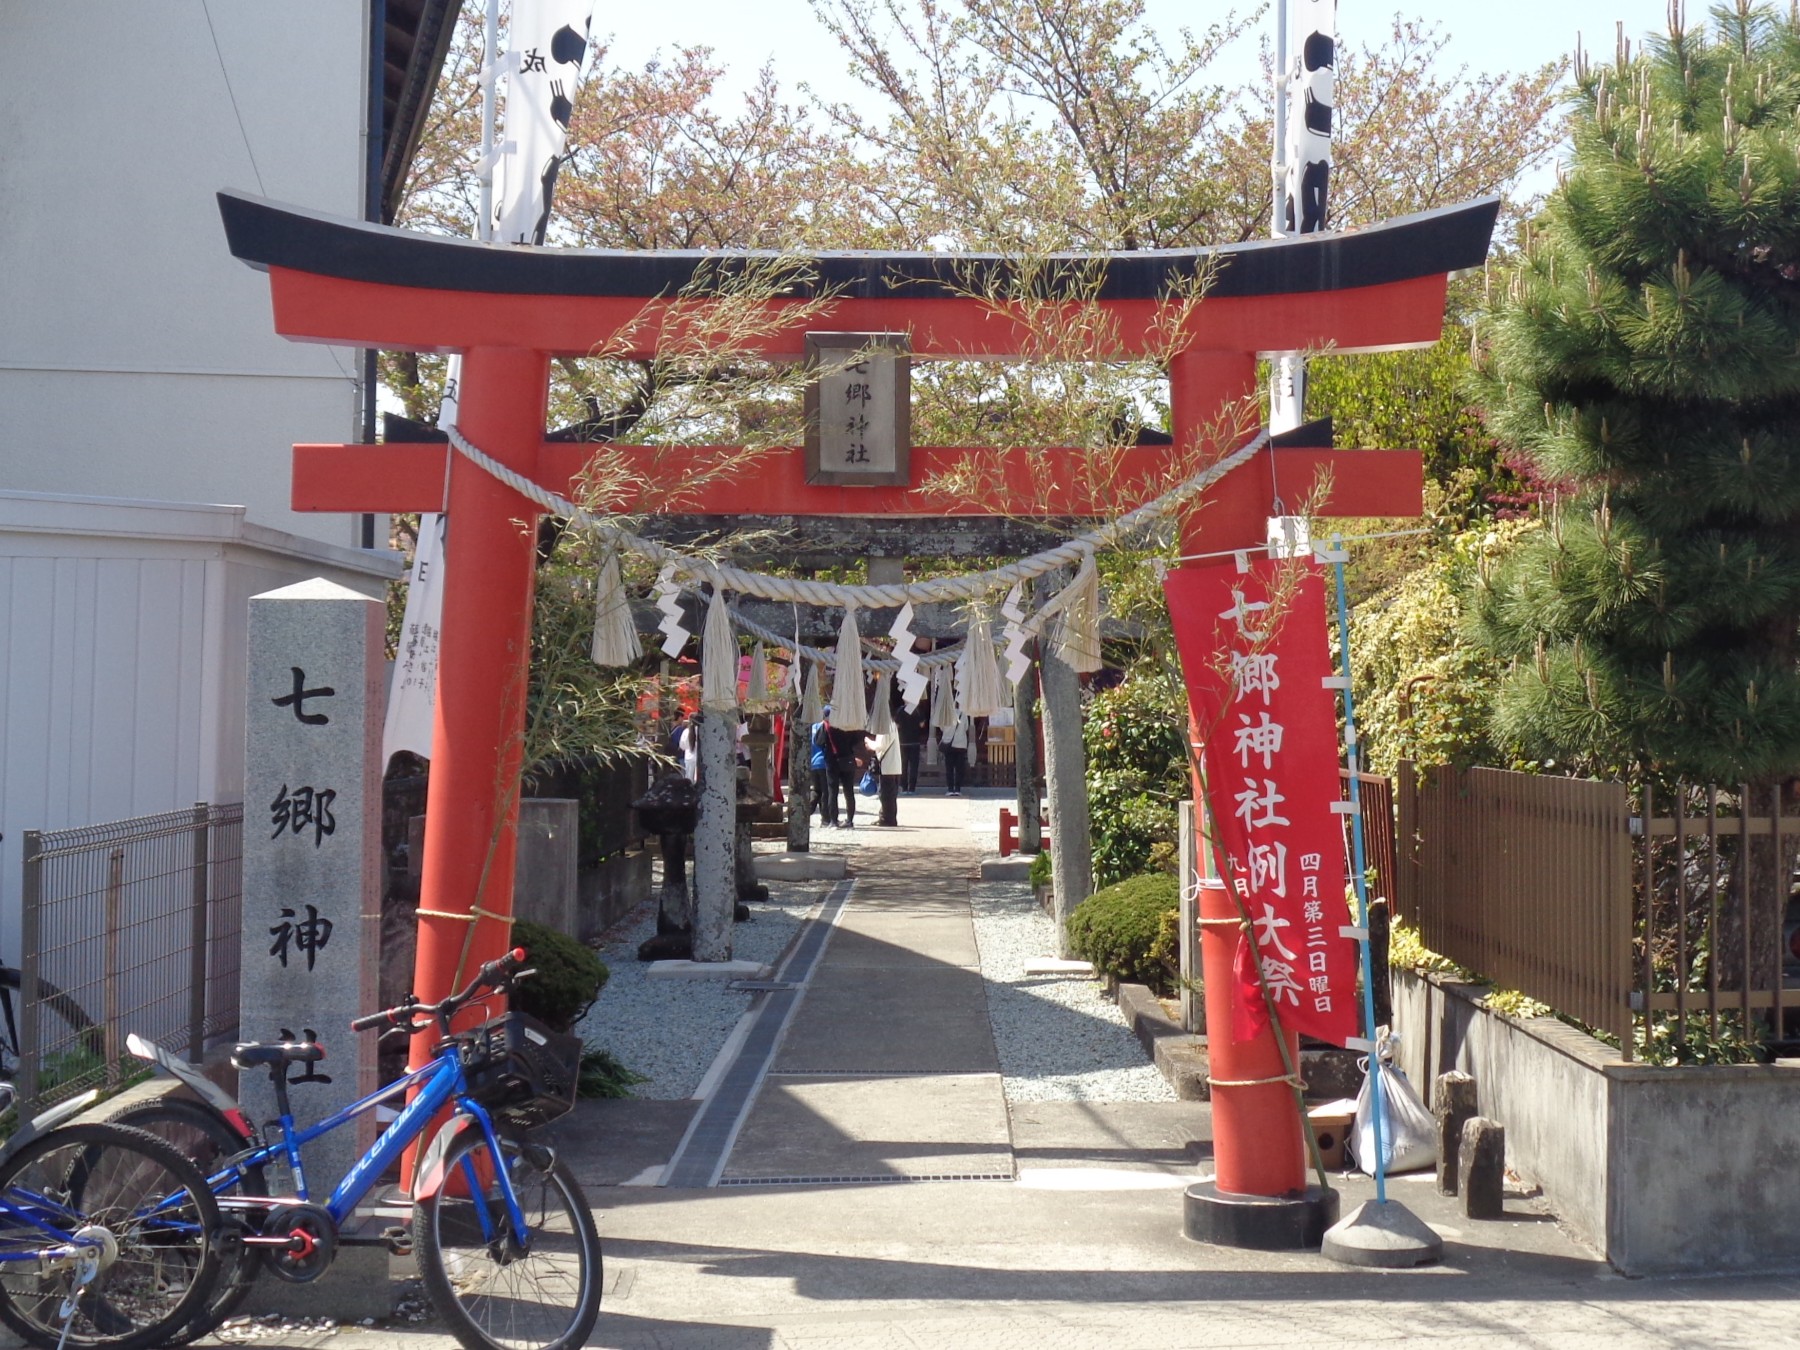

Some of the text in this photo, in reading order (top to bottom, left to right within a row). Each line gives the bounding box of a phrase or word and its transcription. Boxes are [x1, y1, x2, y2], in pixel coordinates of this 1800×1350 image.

[844, 358, 872, 464] 七郷神社
[1218, 590, 1304, 1007] 七郷神社例大祭
[1299, 852, 1332, 1013] 四月第三日曜日
